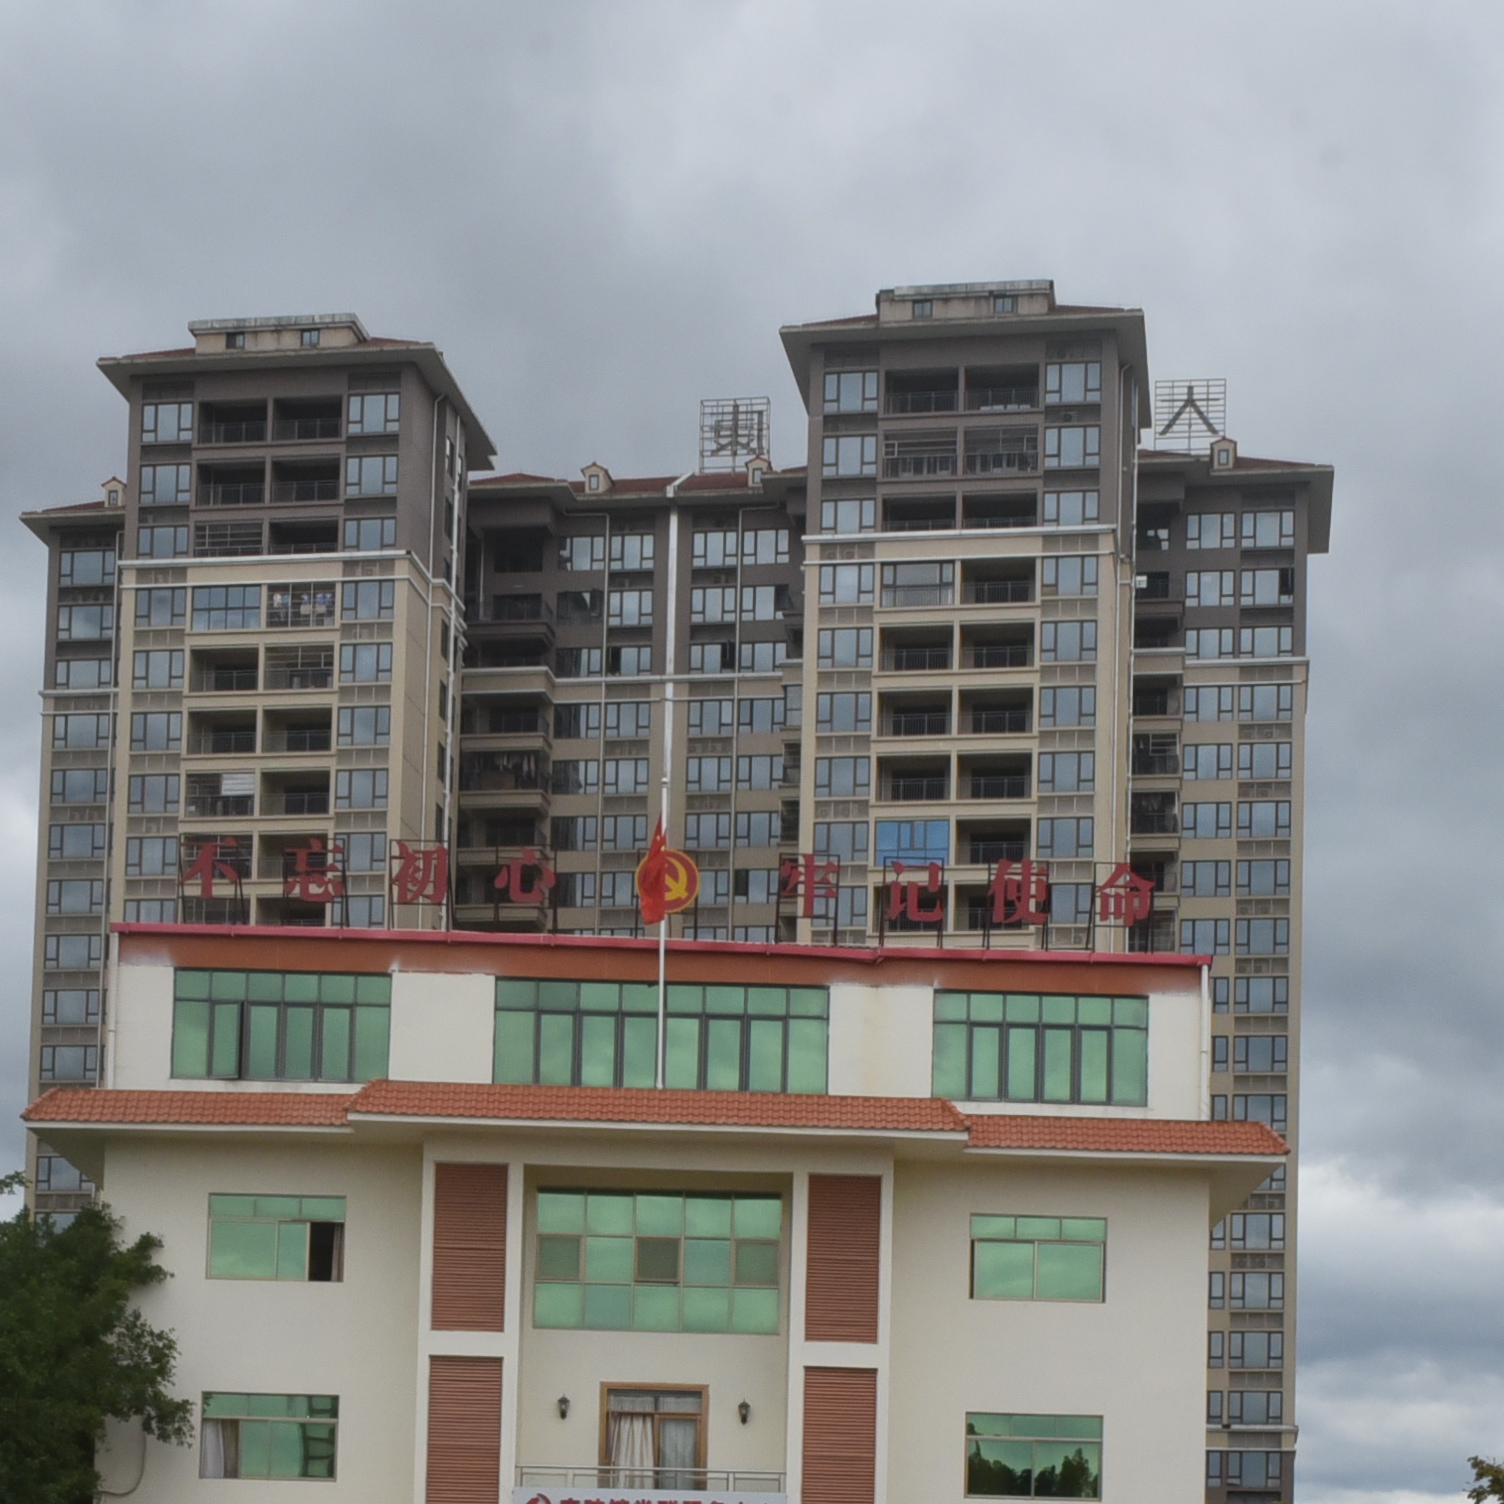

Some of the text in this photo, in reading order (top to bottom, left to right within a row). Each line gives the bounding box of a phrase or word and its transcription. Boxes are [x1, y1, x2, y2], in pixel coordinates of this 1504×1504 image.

[180, 836, 1156, 927] 不忘初心 牢记使命
